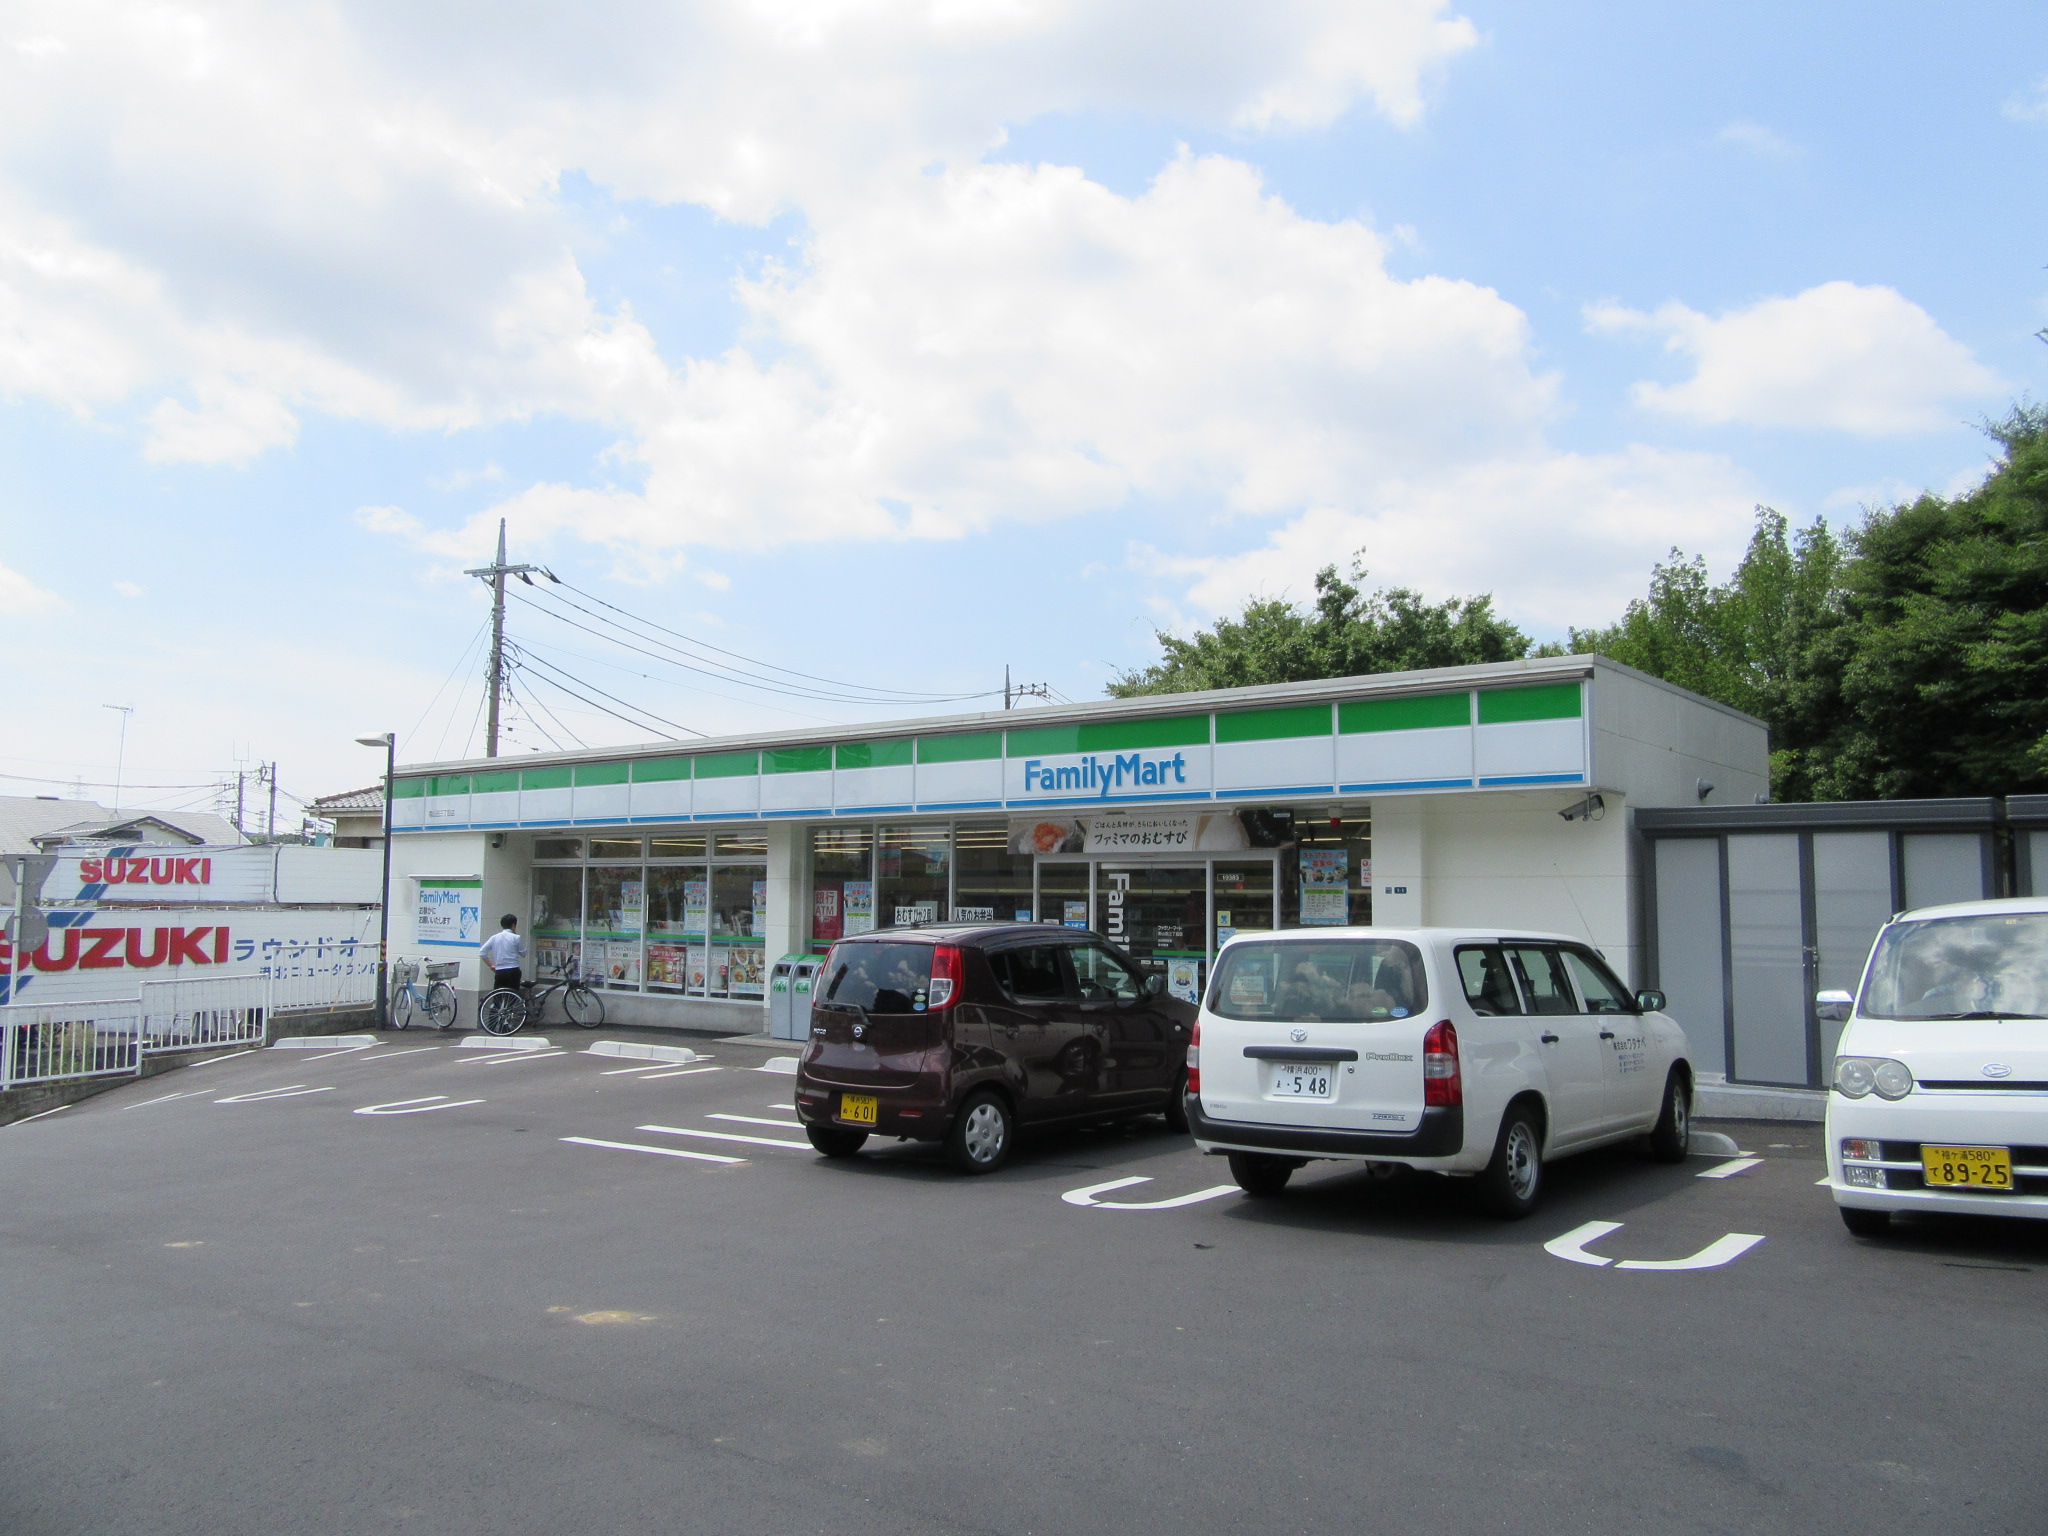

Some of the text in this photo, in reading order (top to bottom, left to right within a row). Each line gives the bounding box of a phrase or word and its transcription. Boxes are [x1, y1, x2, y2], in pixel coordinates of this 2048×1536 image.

[1025, 752, 1186, 797] FamilyMart
[1095, 831, 1188, 845] ファミマのおむすび
[80, 857, 211, 884] SUZUKI
[419, 890, 461, 906] FamilyMart
[816, 892, 835, 904] 銀行
[816, 906, 834, 916] ATM
[956, 909, 993, 921] 人気のお弁当
[1943, 1163, 2008, 1185] 89-25
